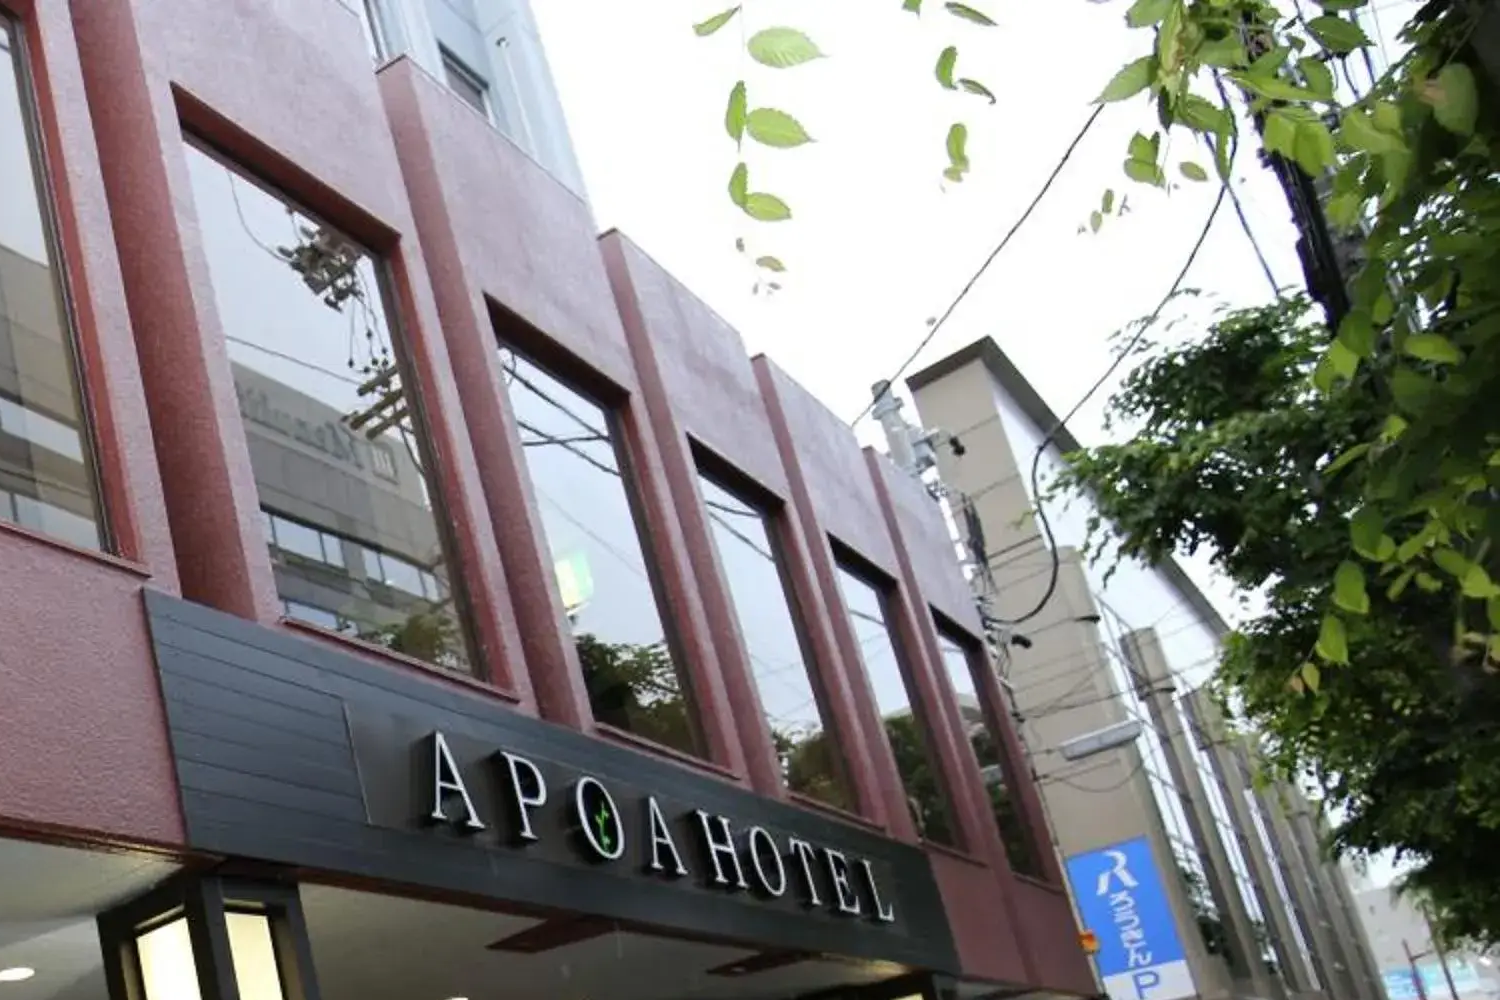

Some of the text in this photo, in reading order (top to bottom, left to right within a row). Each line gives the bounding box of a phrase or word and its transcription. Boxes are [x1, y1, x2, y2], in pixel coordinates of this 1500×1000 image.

[430, 730, 895, 922] APOA HOTEL
[1132, 970, 1160, 1000] P
